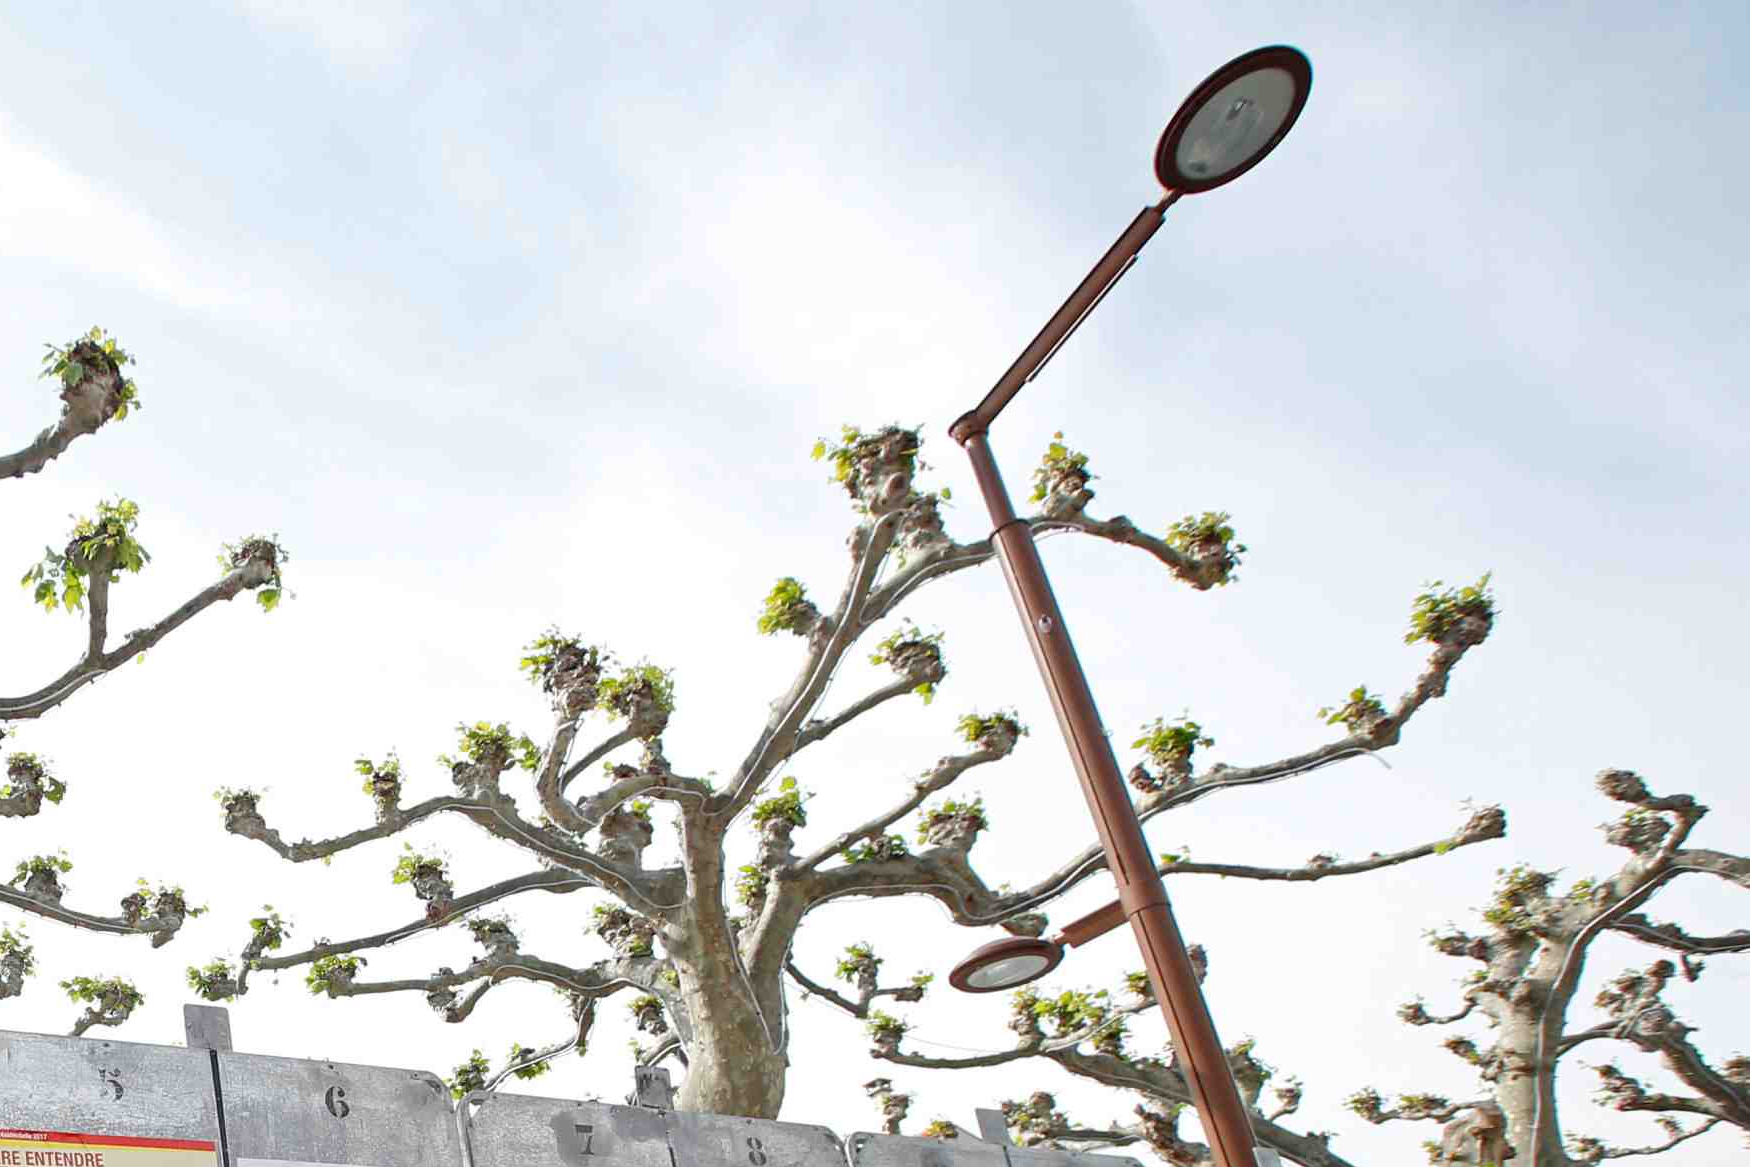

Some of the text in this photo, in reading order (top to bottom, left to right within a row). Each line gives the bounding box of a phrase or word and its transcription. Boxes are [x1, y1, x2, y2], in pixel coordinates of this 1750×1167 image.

[325, 1086, 350, 1118] 6
[575, 1124, 595, 1155] 7
[747, 1136, 767, 1166] 8
[26, 1151, 103, 1167] ENTENDRE
